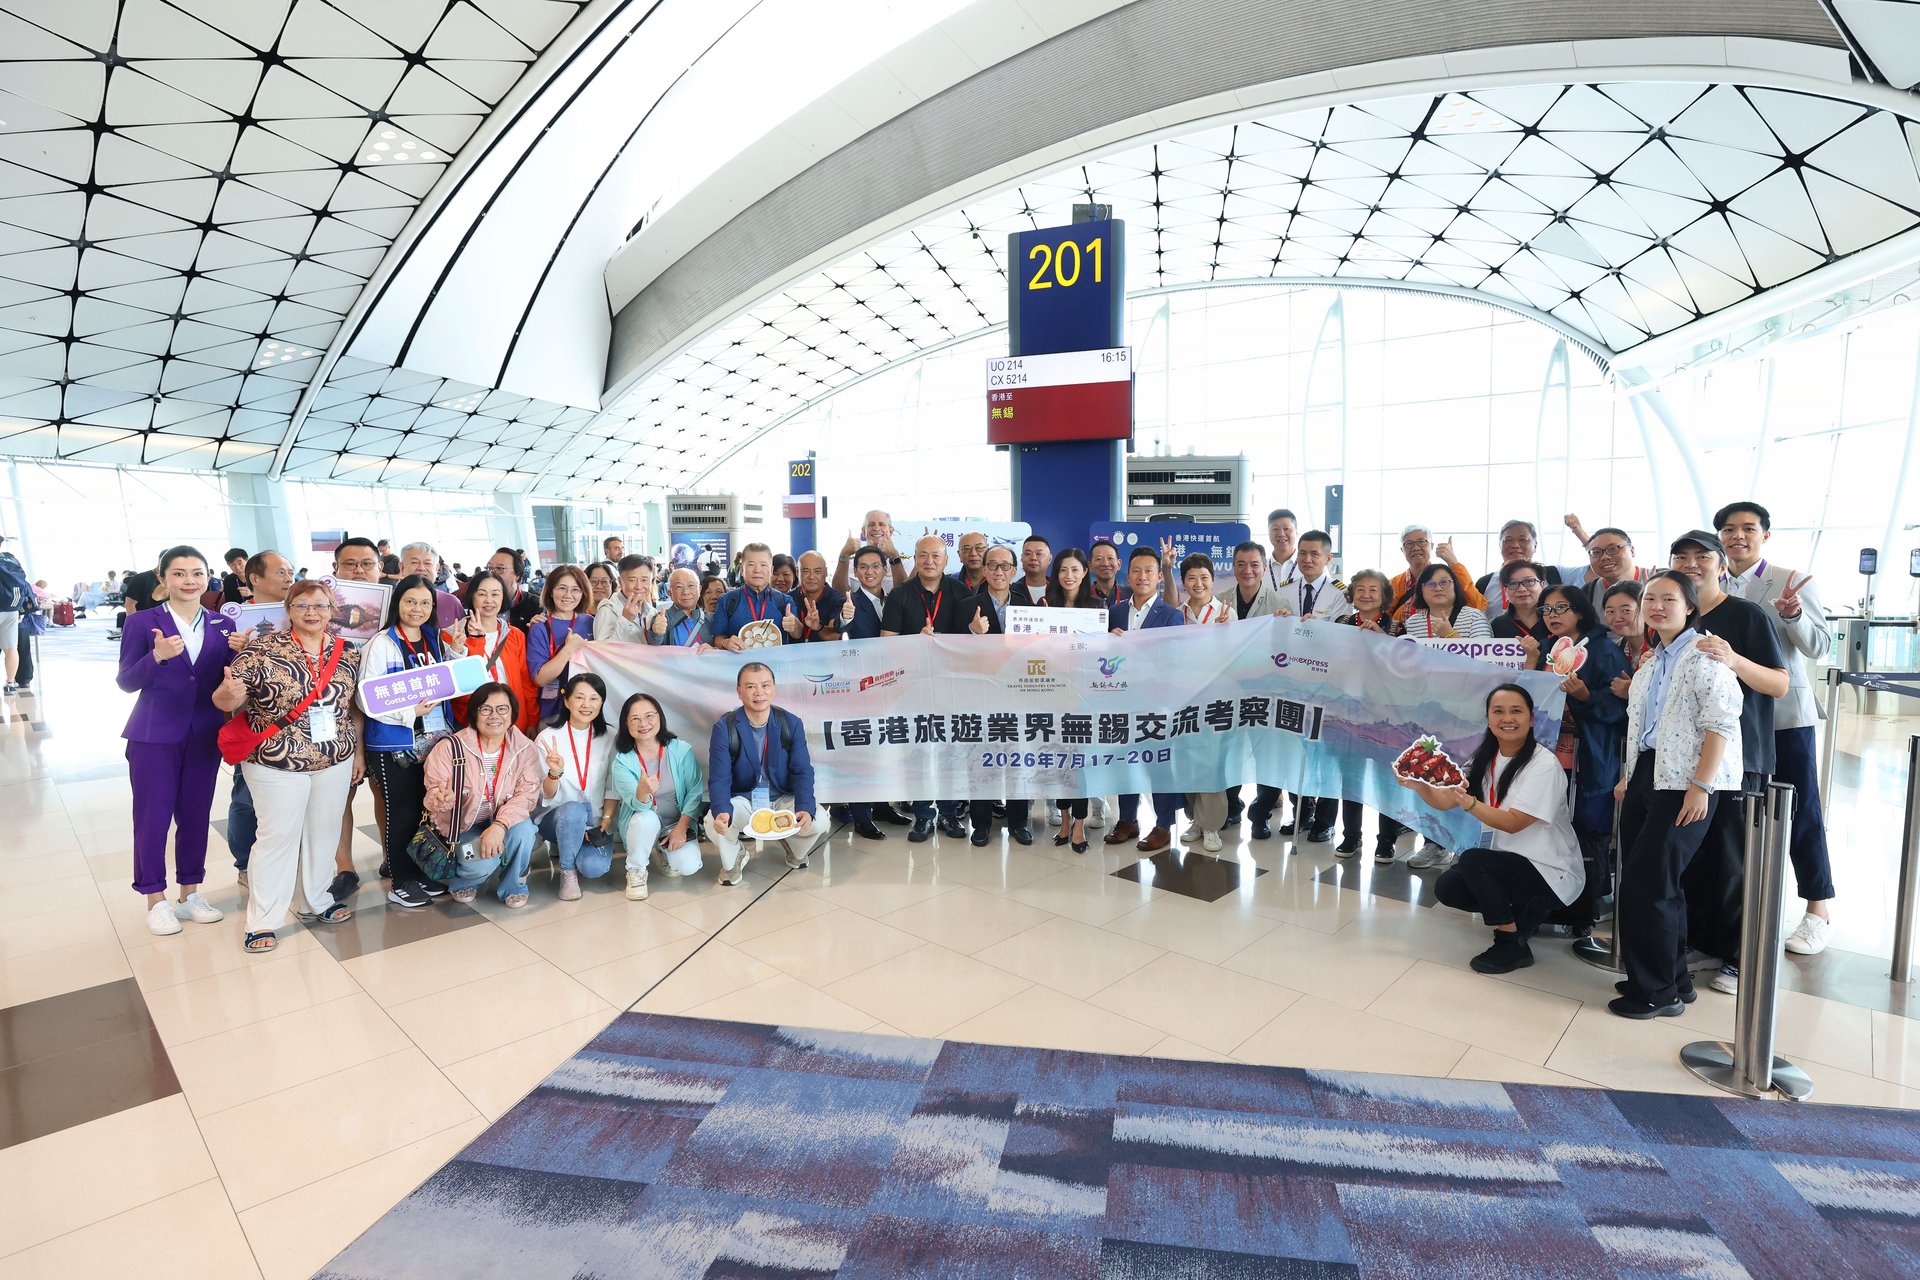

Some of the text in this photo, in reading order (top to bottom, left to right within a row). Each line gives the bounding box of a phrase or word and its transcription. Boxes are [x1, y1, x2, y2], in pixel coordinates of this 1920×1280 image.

[1028, 237, 1102, 290] 201
[1101, 351, 1127, 363] 16:15
[990, 360, 1023, 371] UO 214
[990, 374, 1027, 386] CX 5214
[991, 392, 1013, 401] 香港至
[991, 407, 1014, 419] 無錫
[791, 463, 811, 477] 202
[1212, 562, 1233, 571] WU
[1012, 624, 1068, 634] 香港 無錫
[1425, 643, 1527, 658] express
[374, 673, 441, 699] 無錫首航
[384, 695, 407, 706] Gotta
[407, 693, 418, 701] Go
[982, 748, 1172, 769] 2026年7月17-20日
